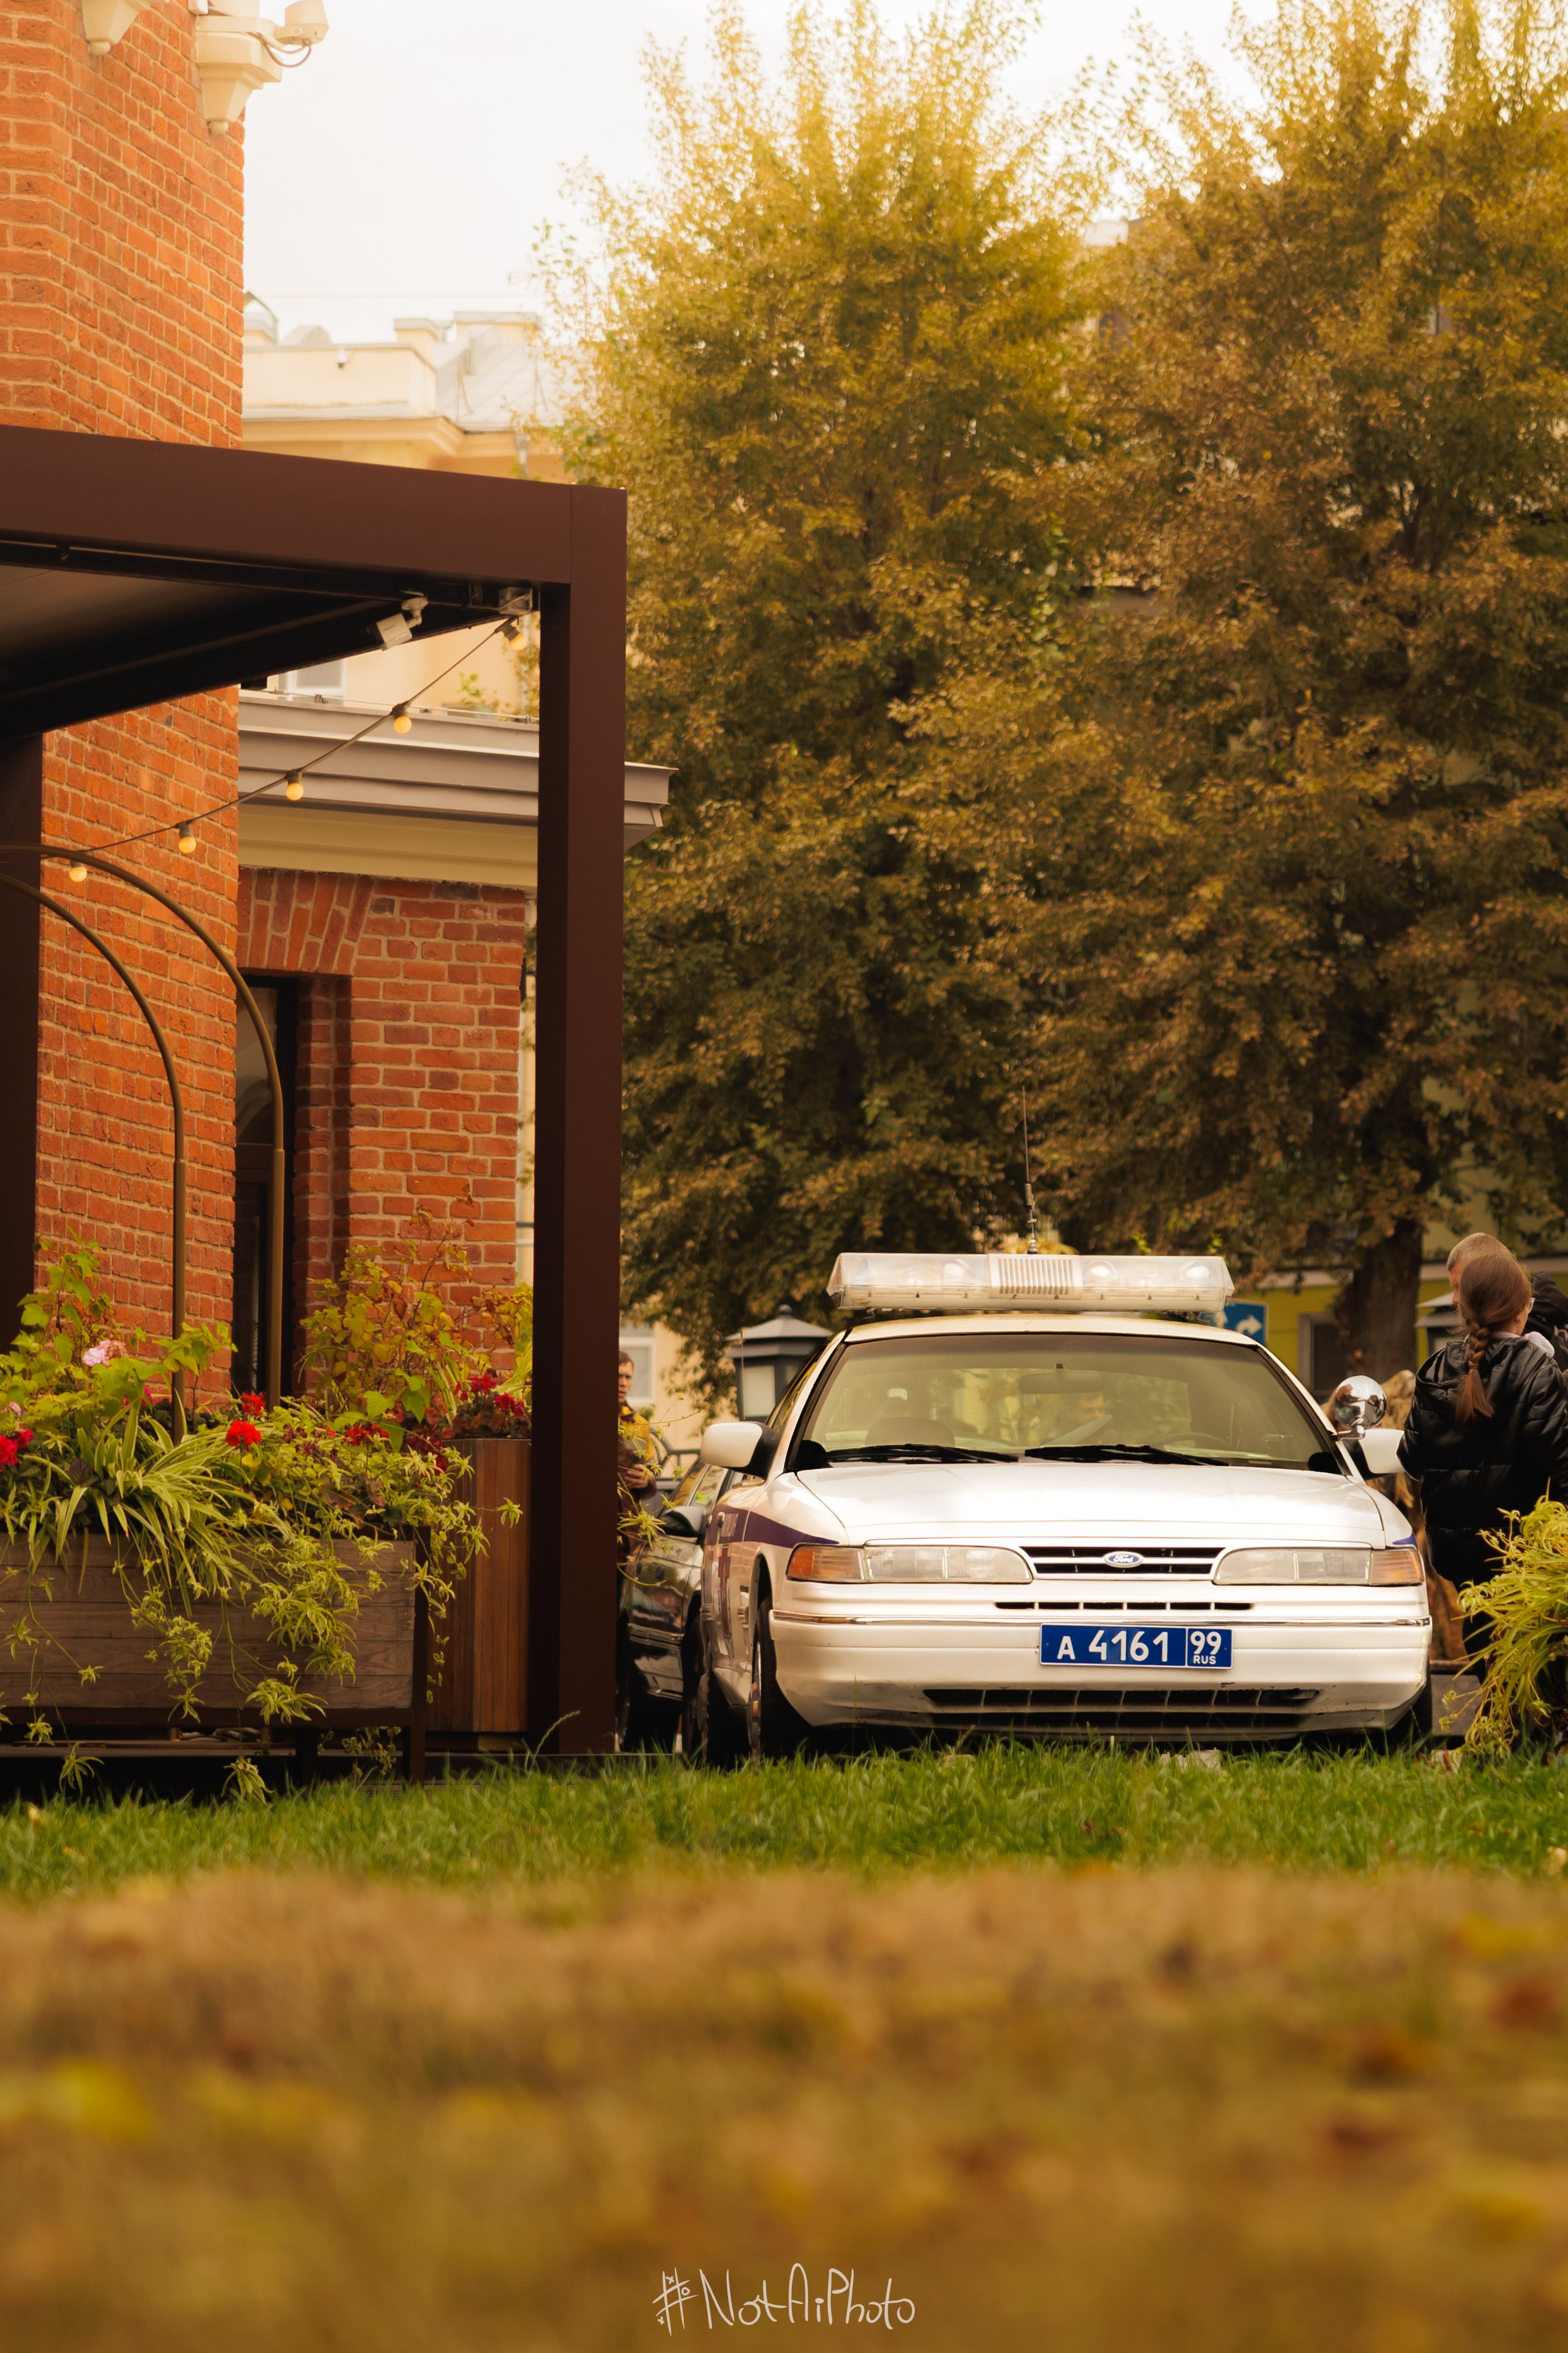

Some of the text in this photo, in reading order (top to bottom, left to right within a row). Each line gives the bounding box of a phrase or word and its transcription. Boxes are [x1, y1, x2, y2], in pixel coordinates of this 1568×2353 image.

[1113, 1555, 1134, 1563] Ford
[1088, 1630, 1168, 1662] 4161
[1190, 1631, 1221, 1655] 99
[1193, 1655, 1216, 1665] RUS
